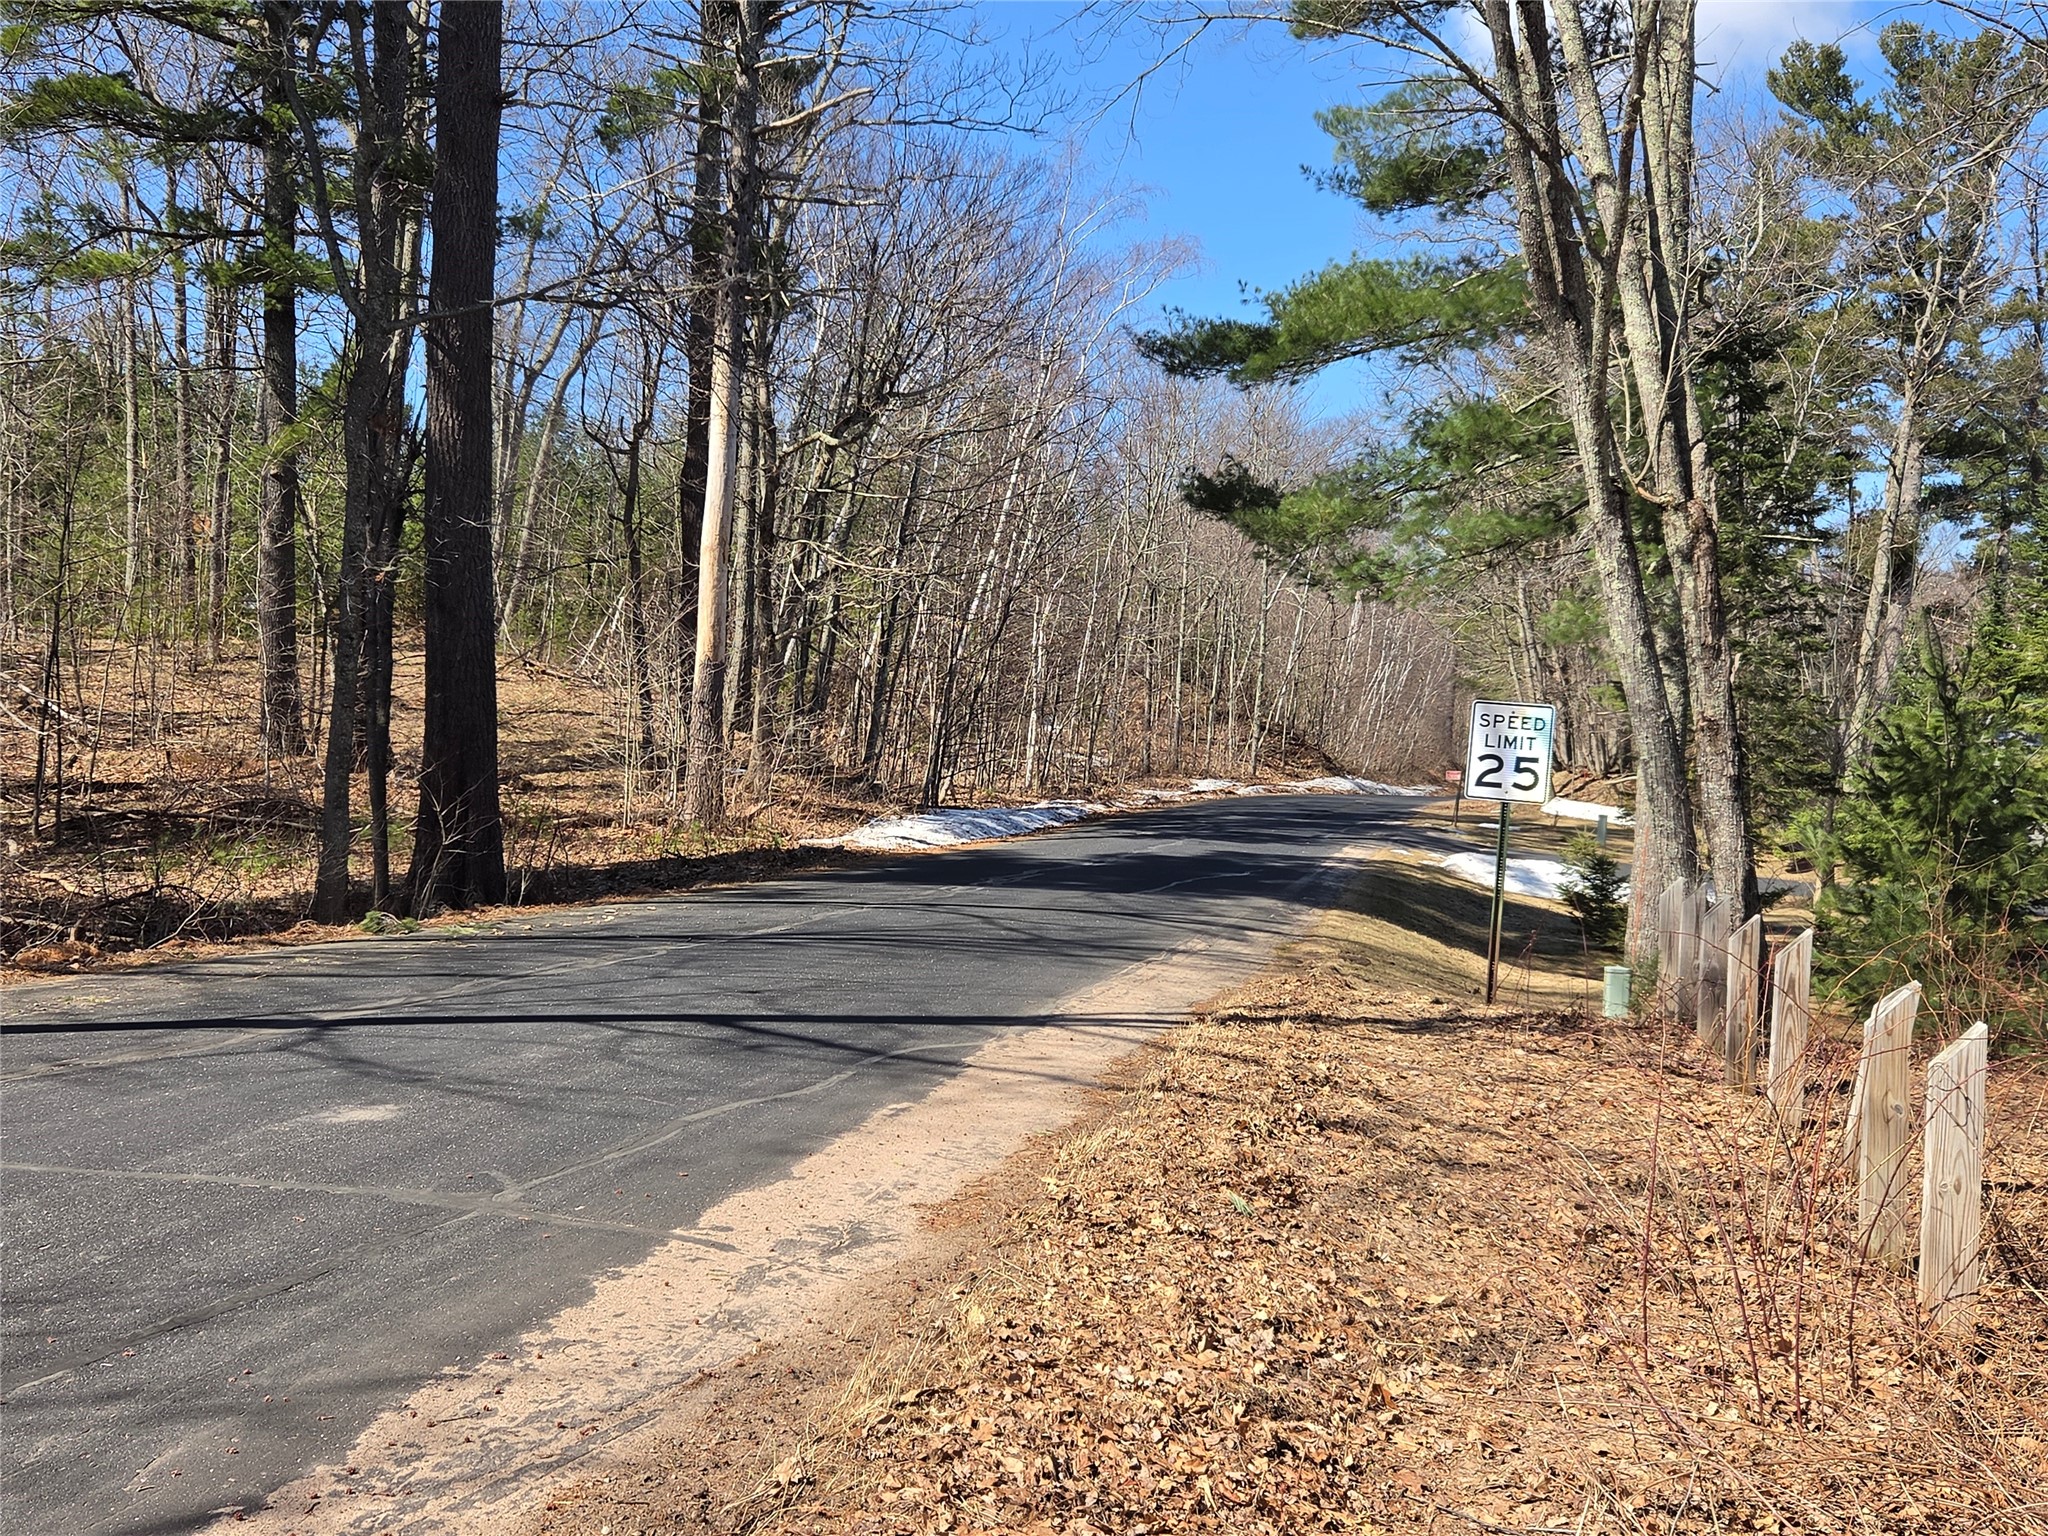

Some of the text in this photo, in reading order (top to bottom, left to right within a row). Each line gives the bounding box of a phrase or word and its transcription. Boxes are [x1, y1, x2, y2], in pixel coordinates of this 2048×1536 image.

[1479, 713, 1546, 731] SPEED
[1484, 733, 1537, 751] LIMIT
[1474, 753, 1540, 791] 25
